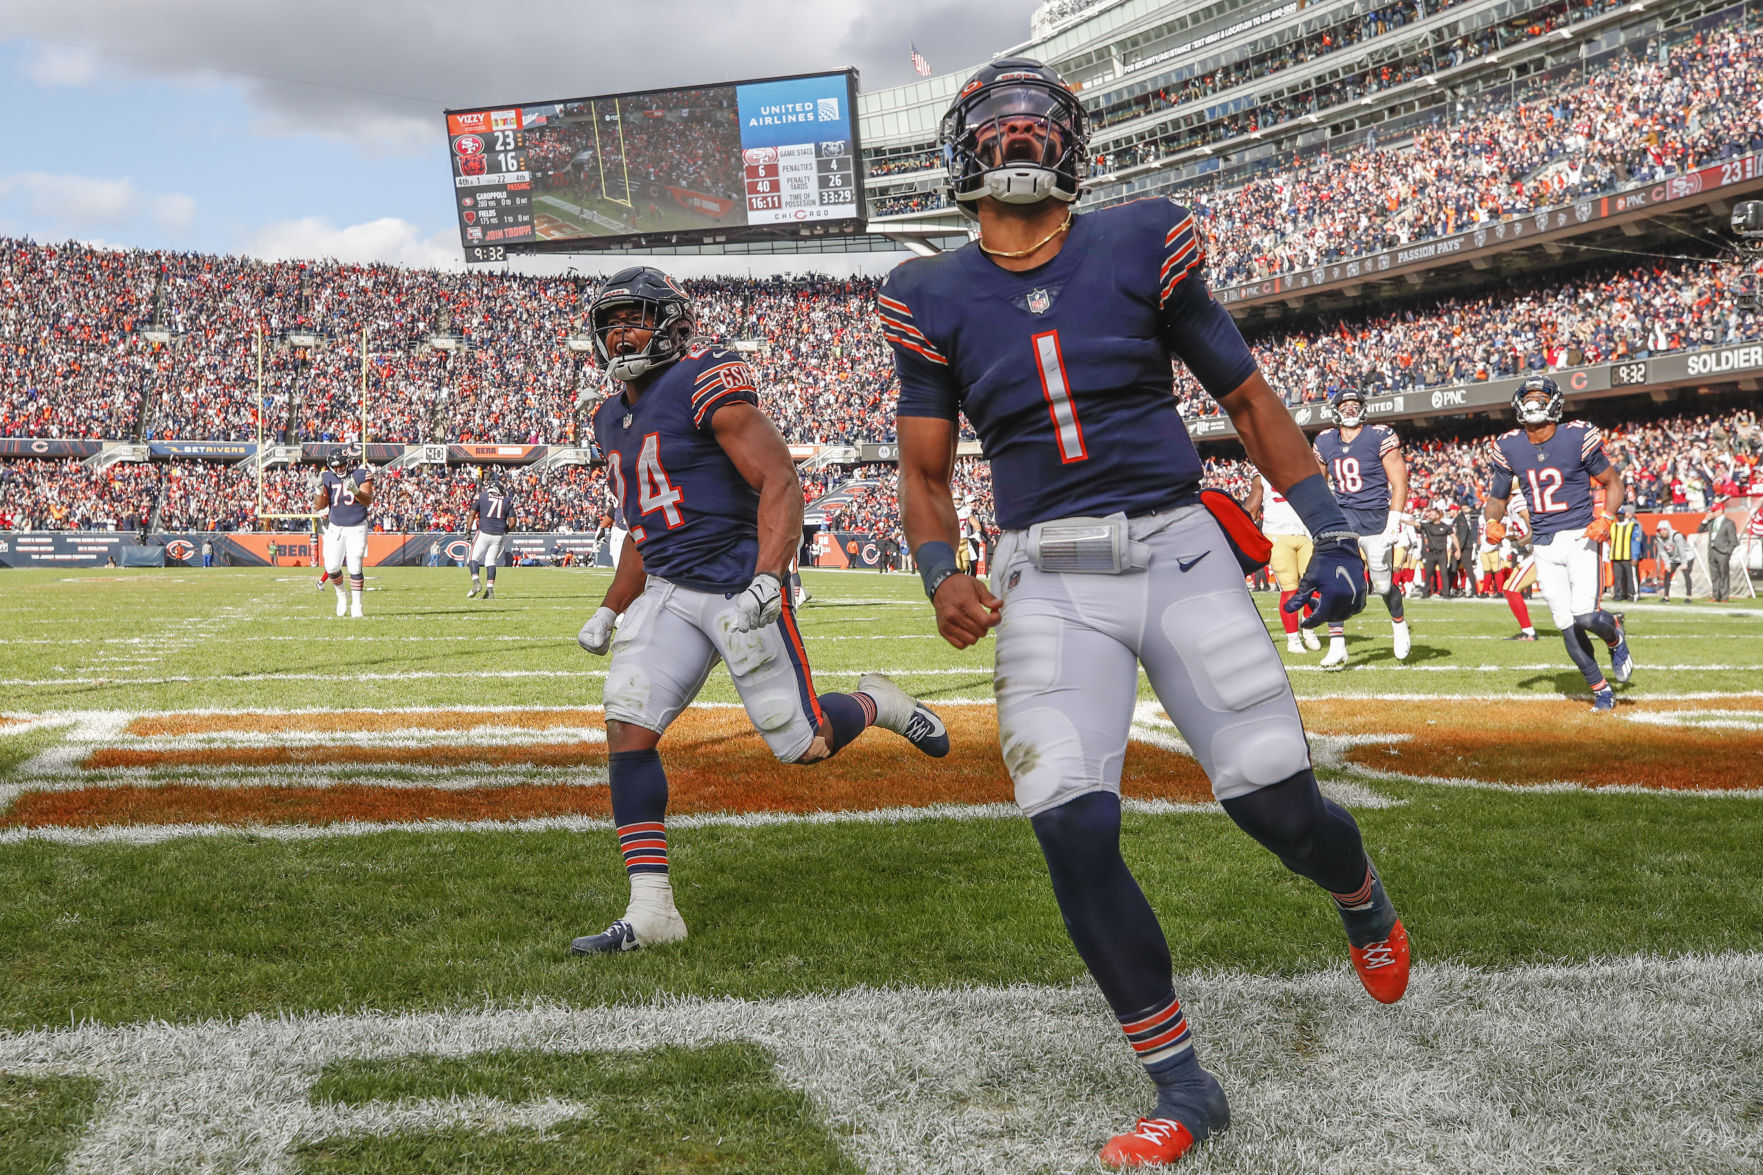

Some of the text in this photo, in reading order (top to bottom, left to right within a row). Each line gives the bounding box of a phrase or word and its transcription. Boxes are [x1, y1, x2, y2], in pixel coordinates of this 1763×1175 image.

[761, 102, 813, 115] UNITED
[457, 113, 485, 123] VIZZY
[749, 112, 815, 127] AIRLINES
[494, 130, 515, 151] 23
[780, 148, 813, 157] GAME STATS
[498, 152, 517, 172] 16
[758, 159, 837, 177] 6 PENALTIES 4
[1721, 161, 1742, 186] 23
[756, 175, 842, 193] 40 PENALTY 26
[751, 196, 779, 209] 16:11
[822, 190, 852, 204] 33:29
[1626, 193, 1646, 208] PNC
[474, 246, 504, 261] 9:32
[1398, 244, 1435, 264] PASSION
[1246, 286, 1259, 296] PNC
[1687, 346, 1763, 375] SOLDIER
[1619, 364, 1646, 383] 9:32
[1031, 329, 1089, 464] 1
[1443, 389, 1466, 406] PNC
[184, 446, 246, 454] BETRIVERS
[426, 447, 444, 460] 40
[1334, 457, 1363, 493] 18
[331, 483, 355, 507] 75
[1526, 467, 1569, 513] 12
[486, 497, 504, 519] 71
[278, 544, 311, 557] BEA
